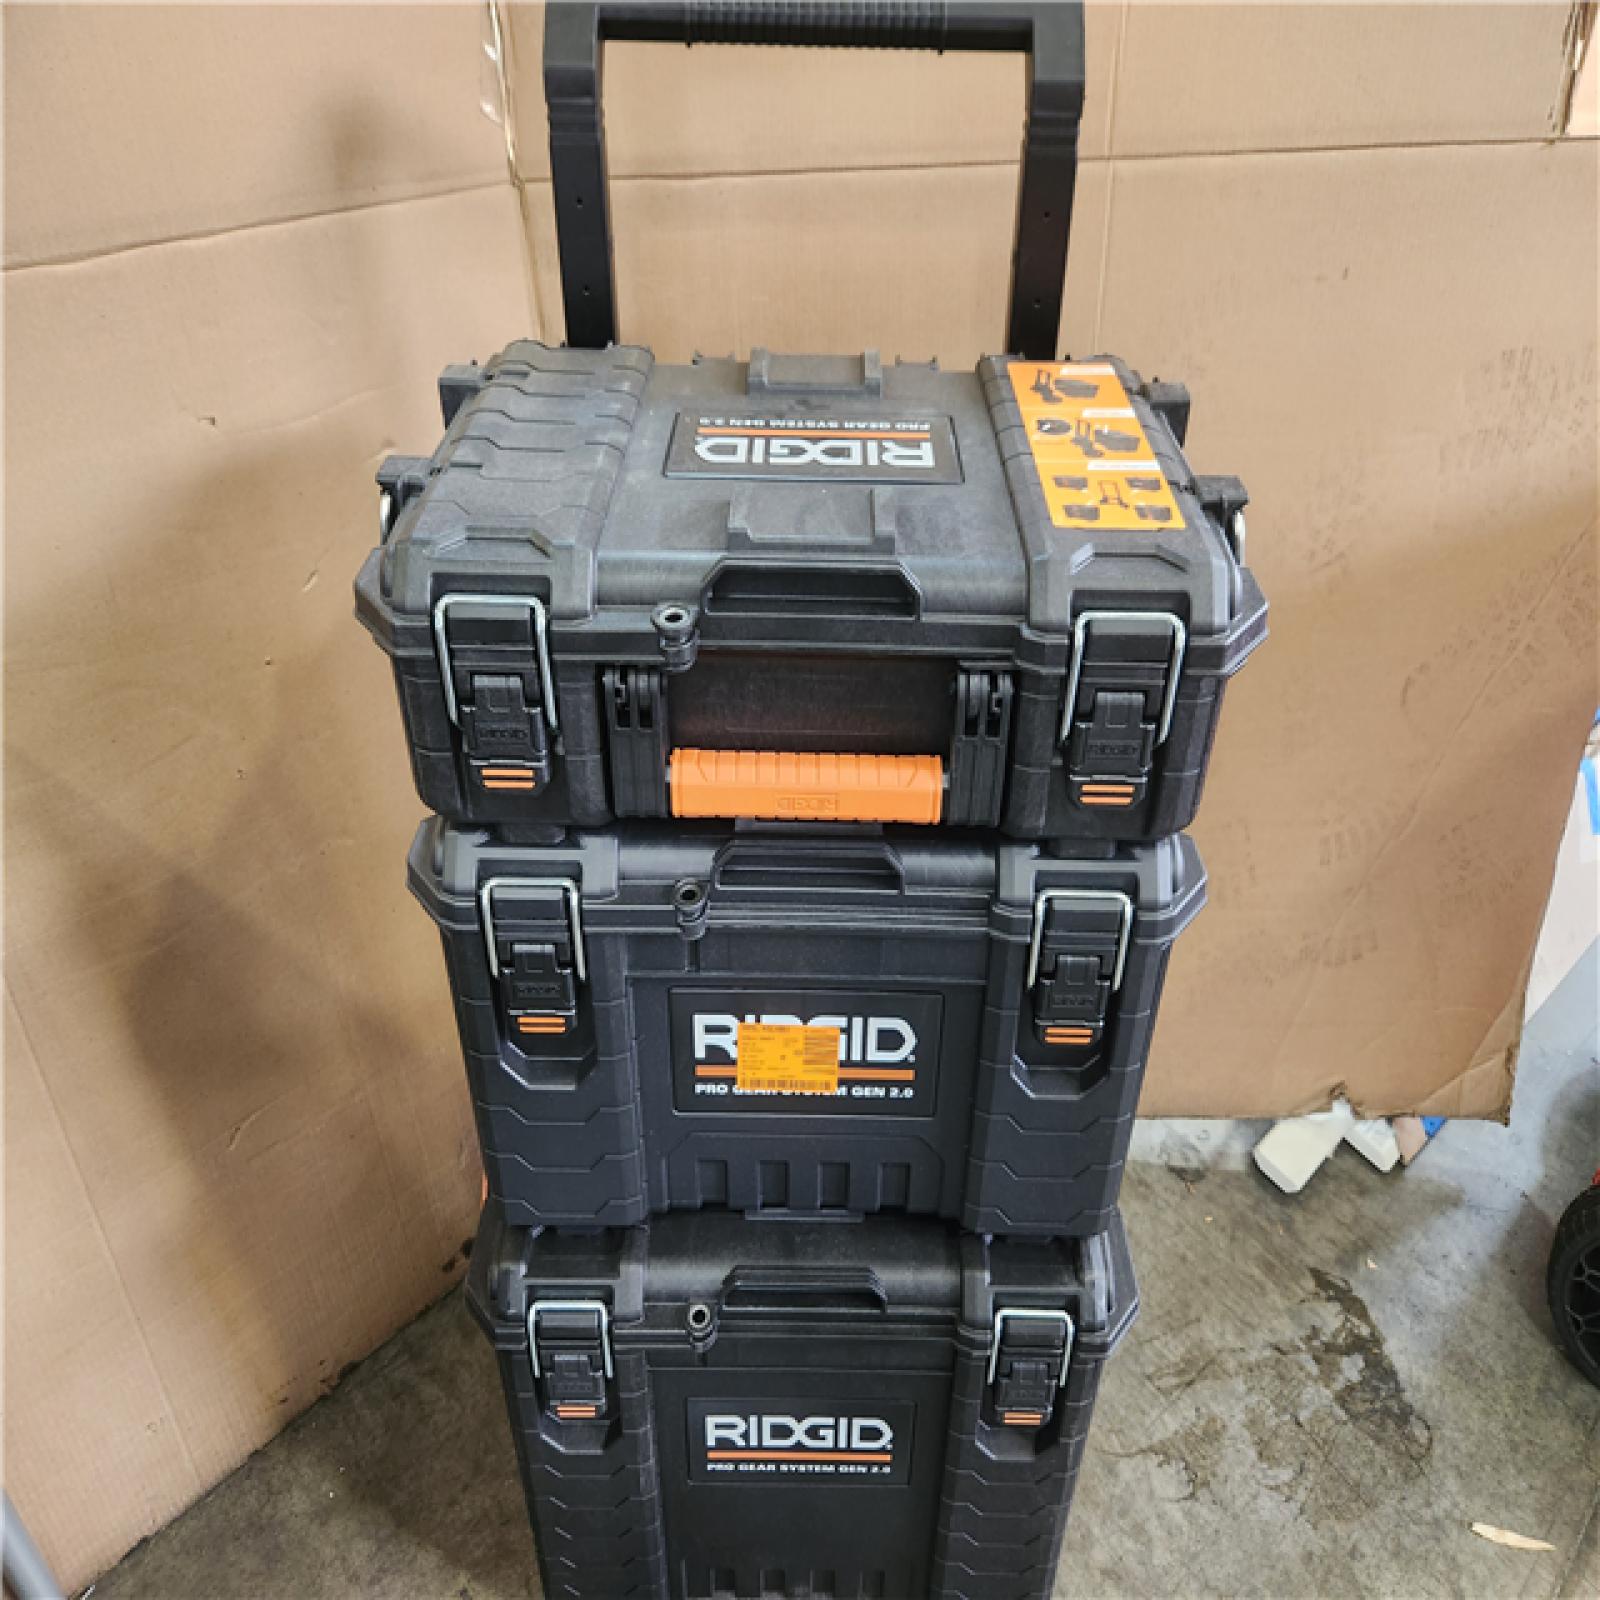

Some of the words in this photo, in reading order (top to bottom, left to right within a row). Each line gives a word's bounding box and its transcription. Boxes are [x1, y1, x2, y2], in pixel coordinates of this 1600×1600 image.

[694, 437, 936, 468] RIDGID
[694, 1084, 728, 1095] PRO
[851, 1087, 886, 1098] GEN
[889, 1087, 914, 1099] 2.0
[705, 1415, 893, 1449] RIDGID
